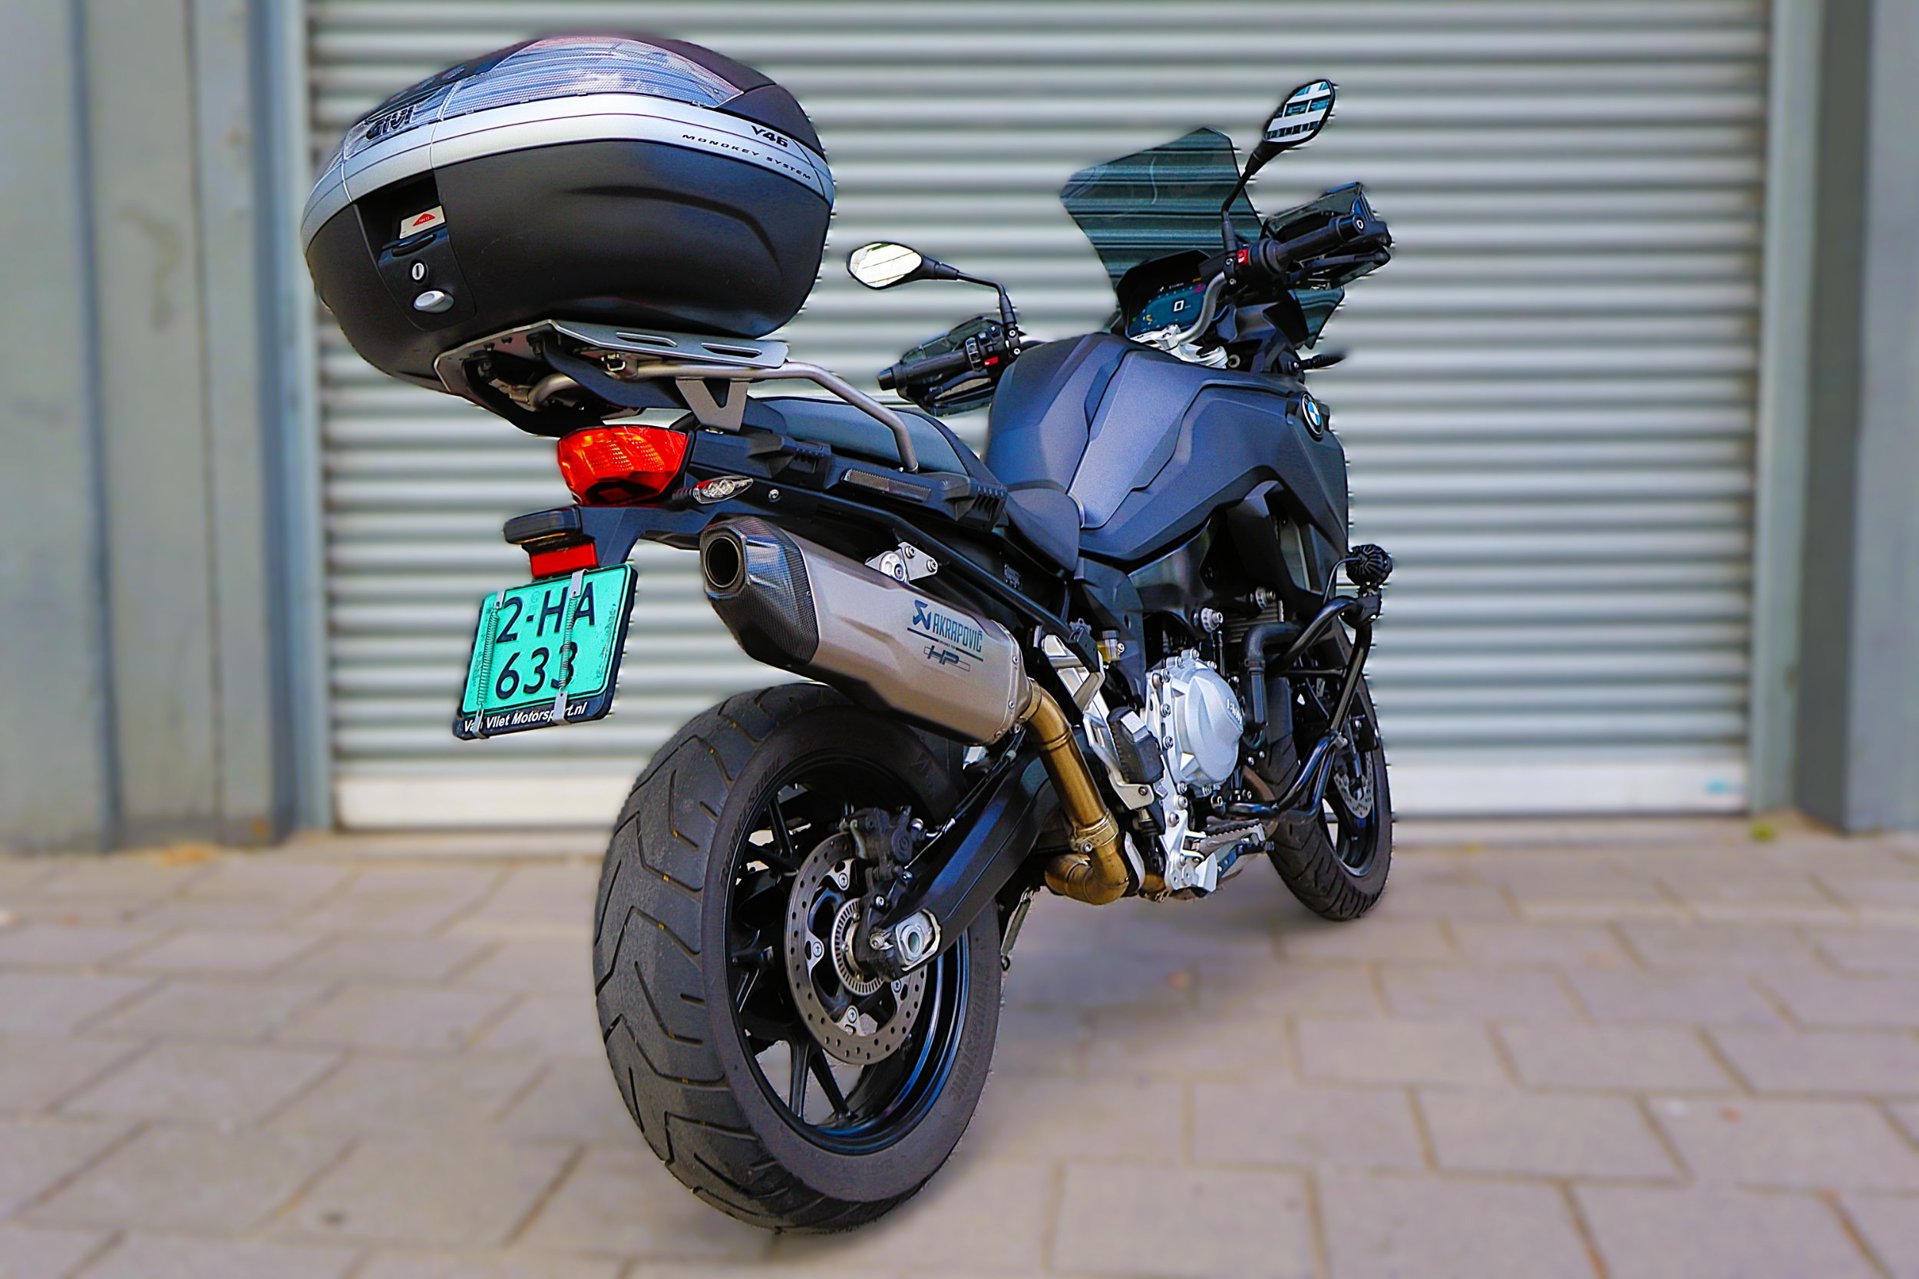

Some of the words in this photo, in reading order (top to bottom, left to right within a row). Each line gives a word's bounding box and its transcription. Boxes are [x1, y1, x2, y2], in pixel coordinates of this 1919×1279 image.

[366, 105, 415, 139] GIVI
[751, 125, 788, 148] V46
[682, 134, 760, 157] MONOKEY
[766, 156, 811, 180] SYSTEM
[495, 581, 596, 644] 2-HA
[495, 641, 578, 700] 633
[487, 714, 510, 729] Vliet
[511, 701, 588, 725] Motorspt.nl
